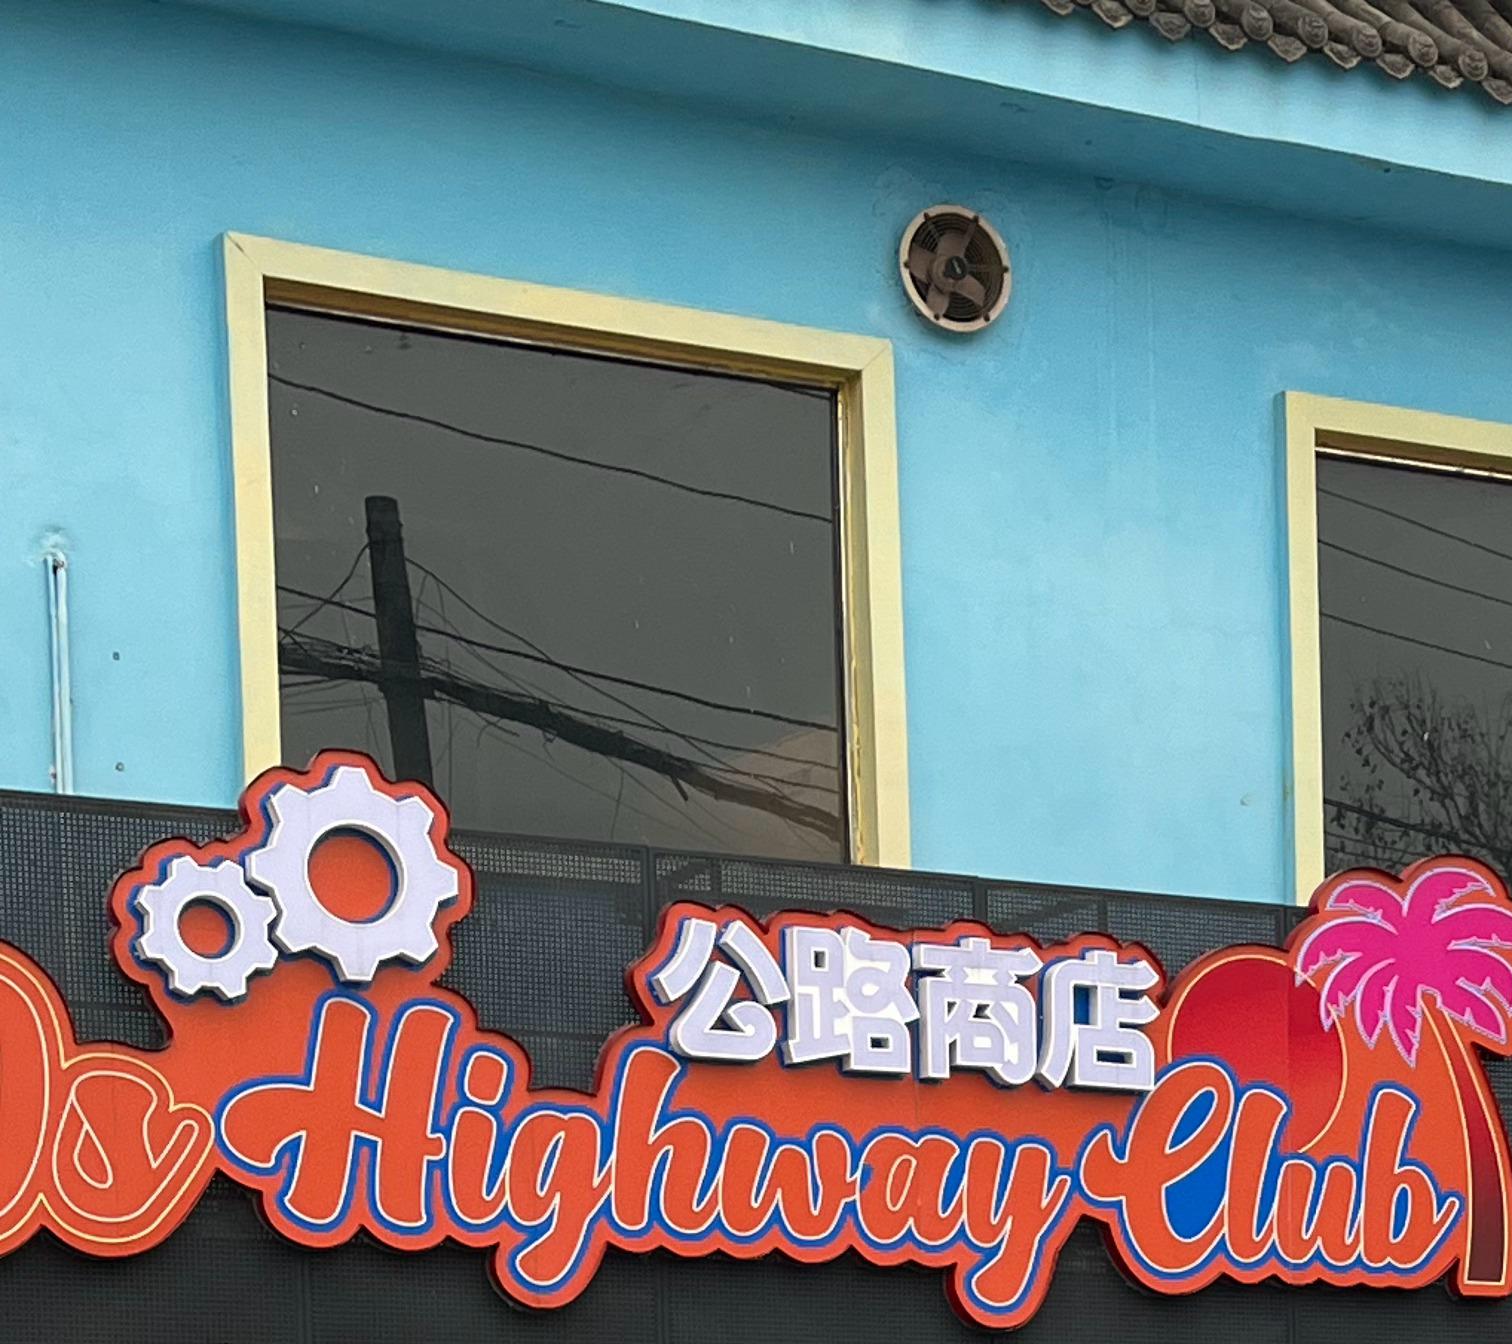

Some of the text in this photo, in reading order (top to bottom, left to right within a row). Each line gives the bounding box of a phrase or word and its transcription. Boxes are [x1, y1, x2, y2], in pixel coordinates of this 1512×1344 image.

[652, 914, 1162, 1092] 公路商店
[216, 995, 1070, 1306] Highway
[1080, 1059, 1461, 1274] Club
